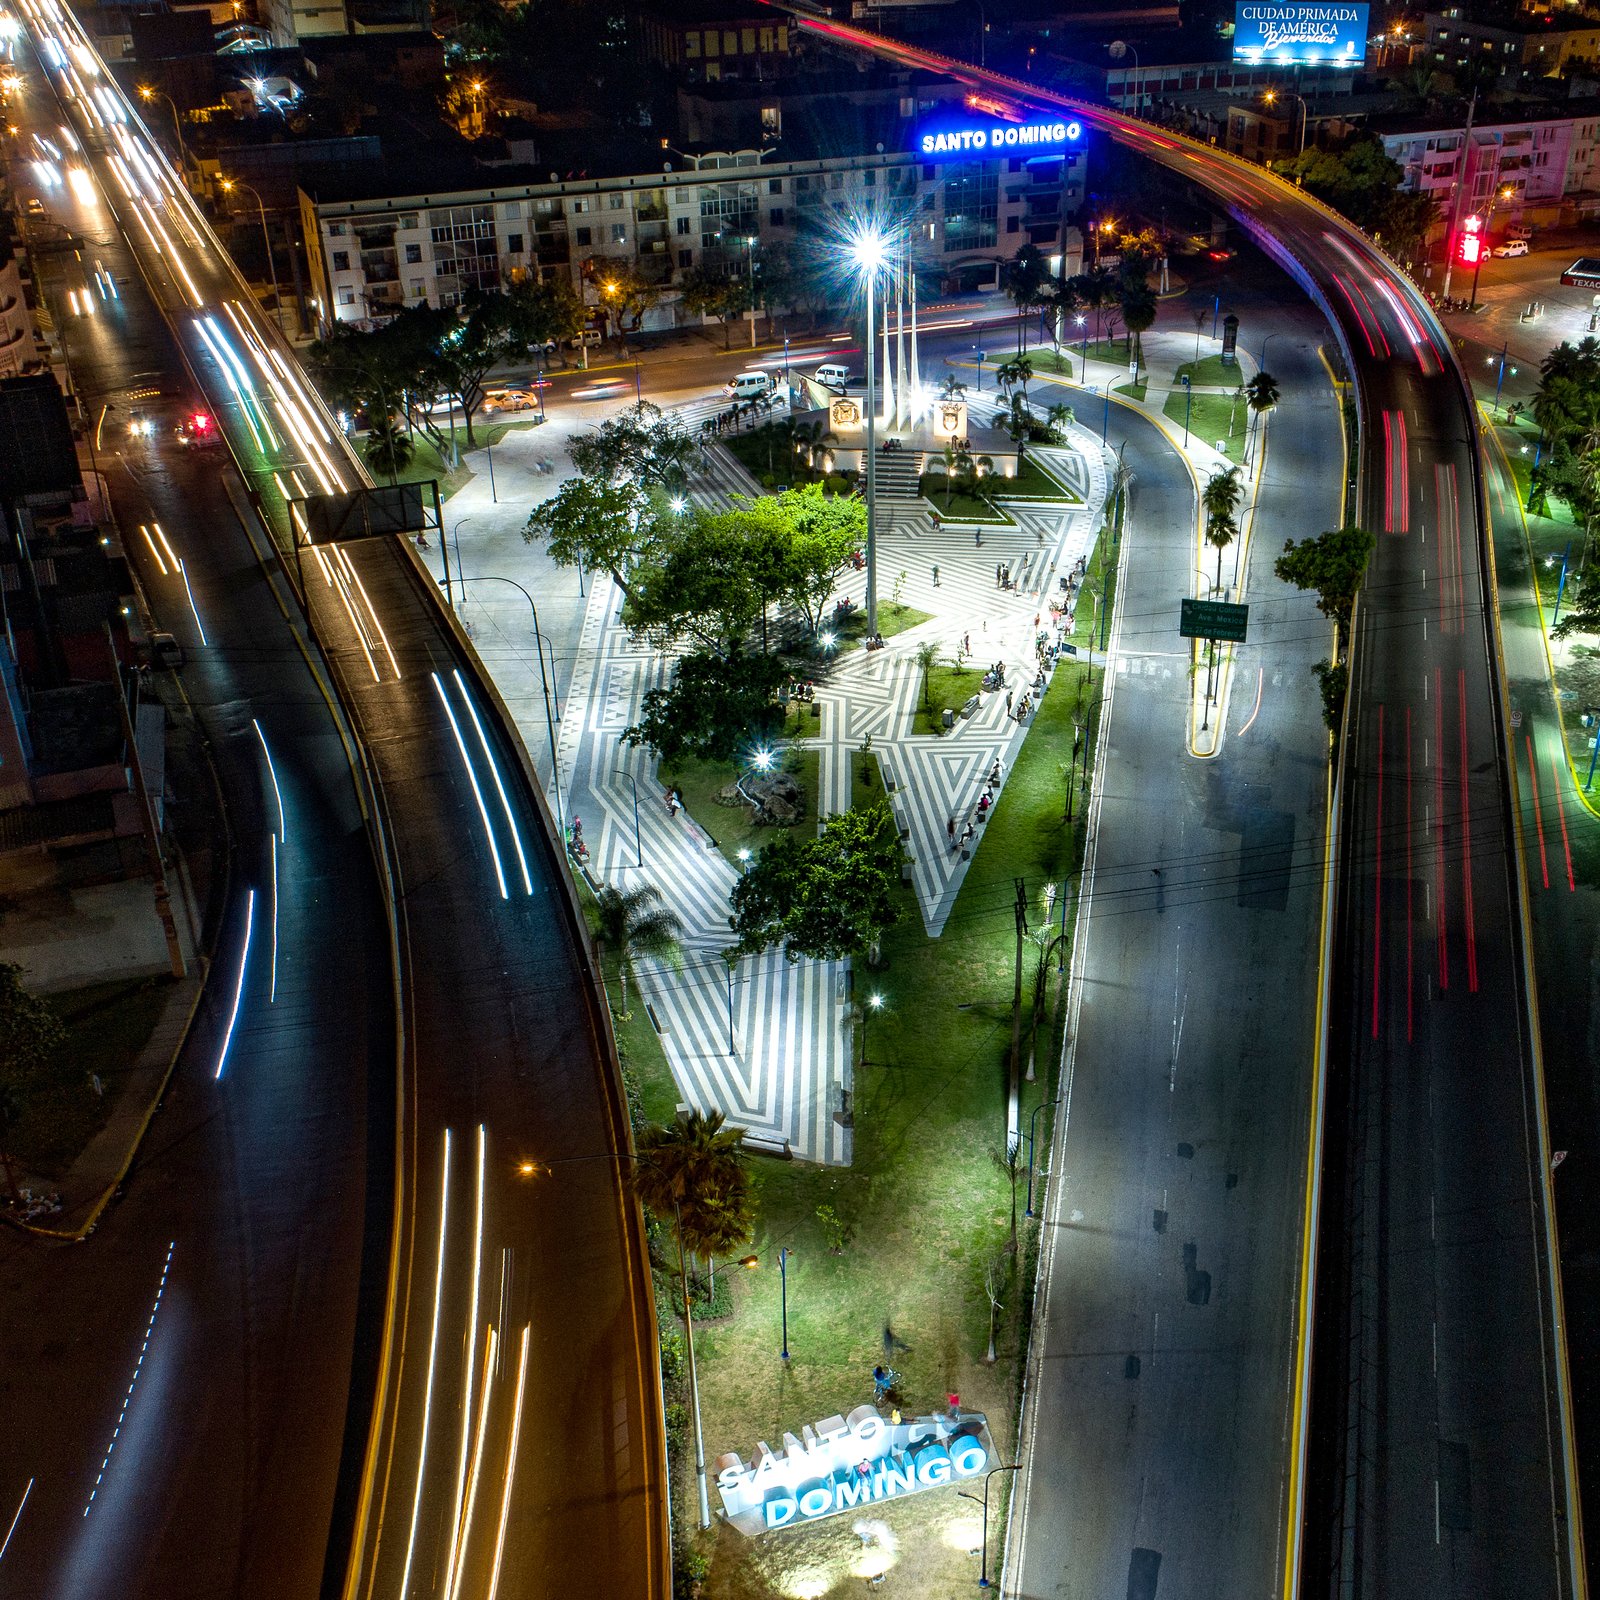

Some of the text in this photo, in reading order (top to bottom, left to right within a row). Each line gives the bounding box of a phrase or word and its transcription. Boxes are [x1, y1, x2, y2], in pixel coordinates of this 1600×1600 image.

[1242, 7, 1358, 21] CIUDAD PRIMADA
[1258, 20, 1339, 35] DE AMÉRICA
[1263, 31, 1336, 51] Bienvenidos
[922, 122, 1081, 153] SANTO DOMINGO
[1213, 628, 1239, 637] Febrero
[718, 1415, 886, 1489] SANTO
[765, 1447, 988, 1528] DOMINGO
